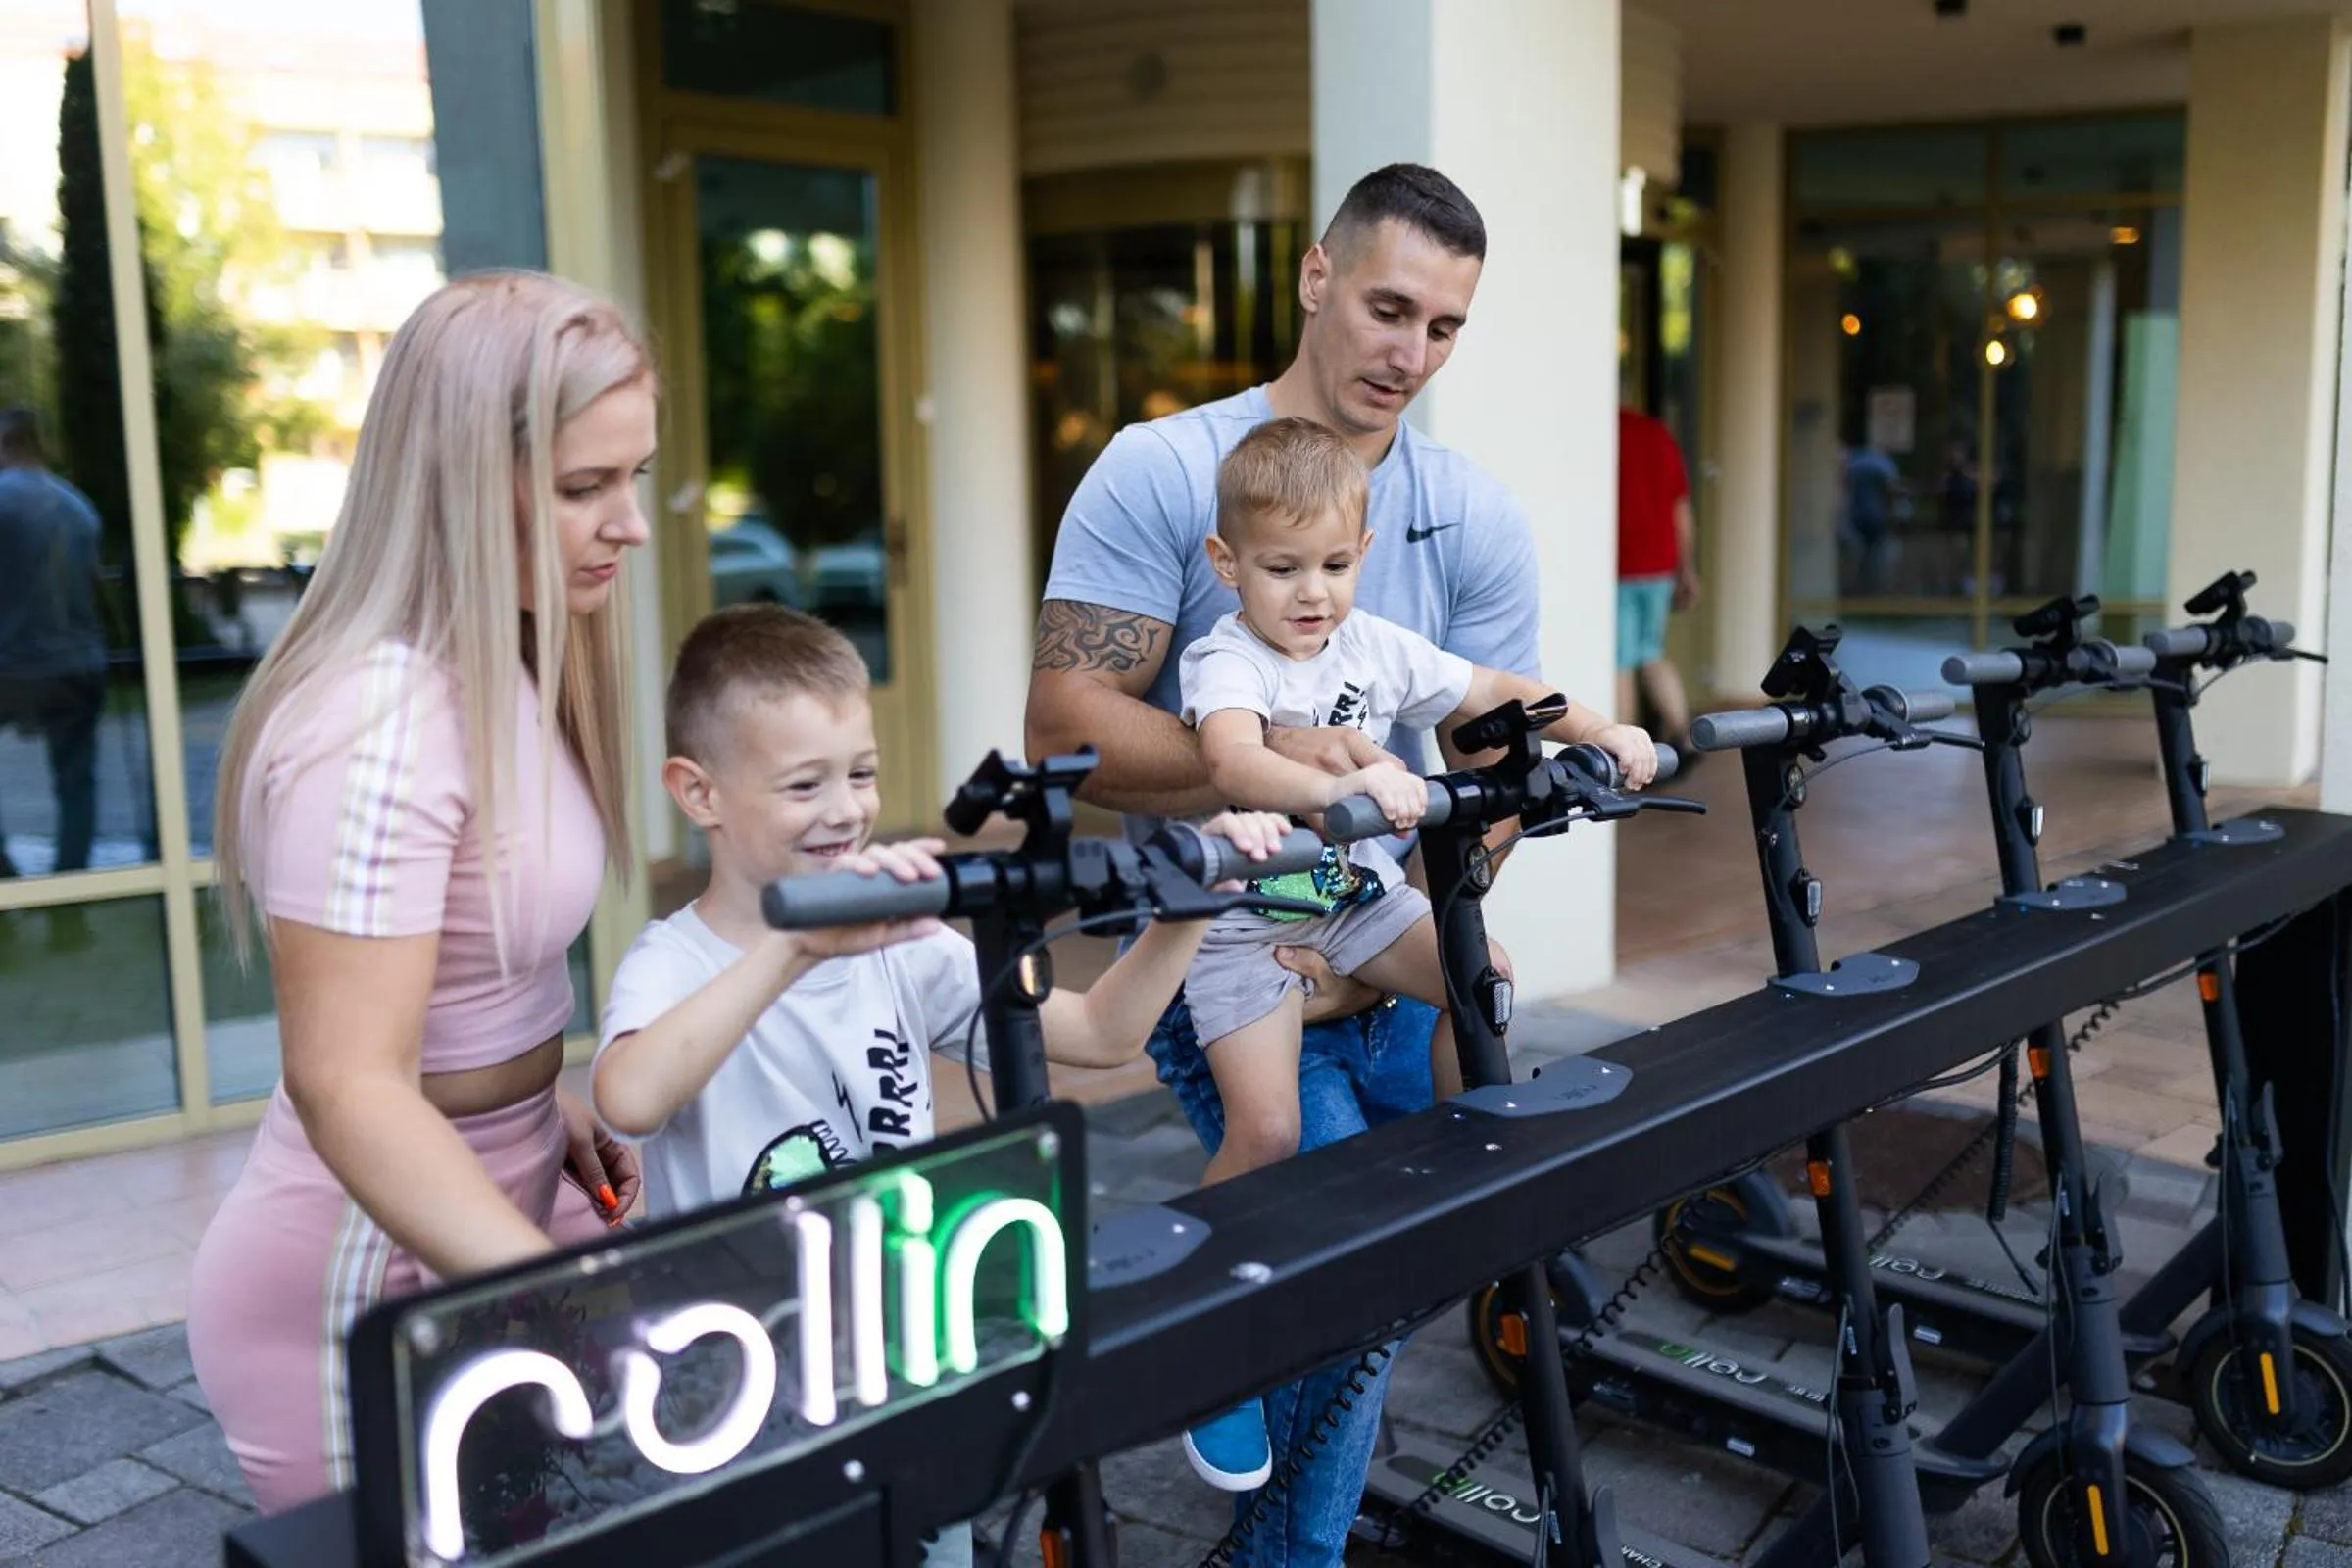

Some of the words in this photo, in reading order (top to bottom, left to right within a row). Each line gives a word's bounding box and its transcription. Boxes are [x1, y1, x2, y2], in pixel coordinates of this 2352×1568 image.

[1867, 1253, 1946, 1280] roll
[422, 1170, 1070, 1561] rollin
[1658, 1343, 1768, 1384] rollin
